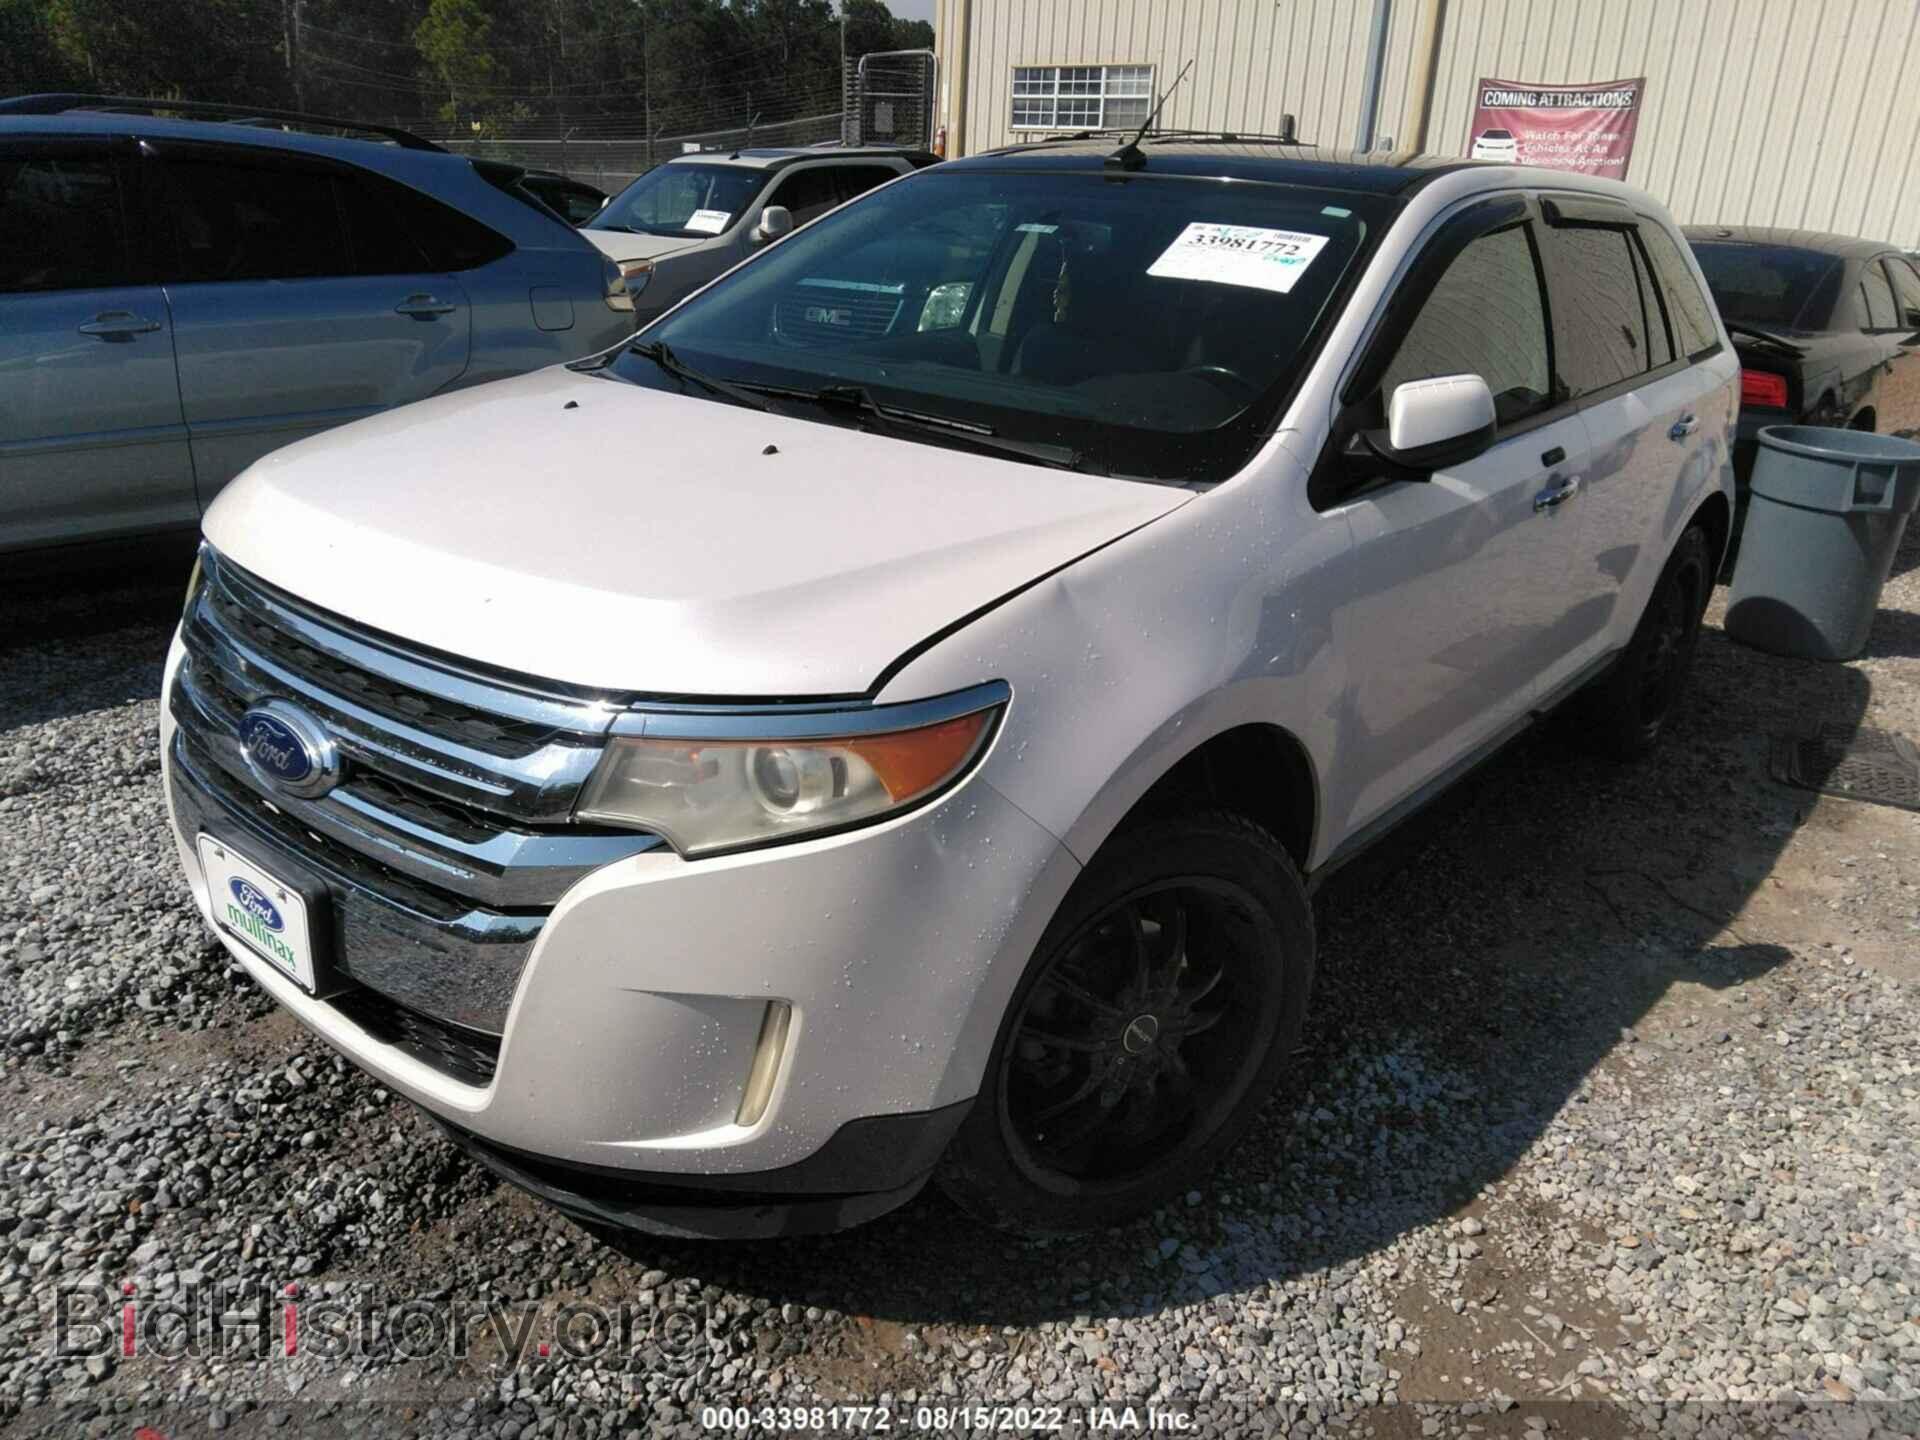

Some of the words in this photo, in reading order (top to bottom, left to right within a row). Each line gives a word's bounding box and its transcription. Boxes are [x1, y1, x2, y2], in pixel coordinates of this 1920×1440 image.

[1484, 91, 1537, 106] COMING
[1539, 91, 1633, 107] ATTRACTIONS
[1189, 234, 1300, 256] 33981772
[805, 307, 852, 326] GMC
[247, 720, 296, 770] Ford
[240, 884, 275, 924] Ford
[226, 903, 297, 969] mullinax
